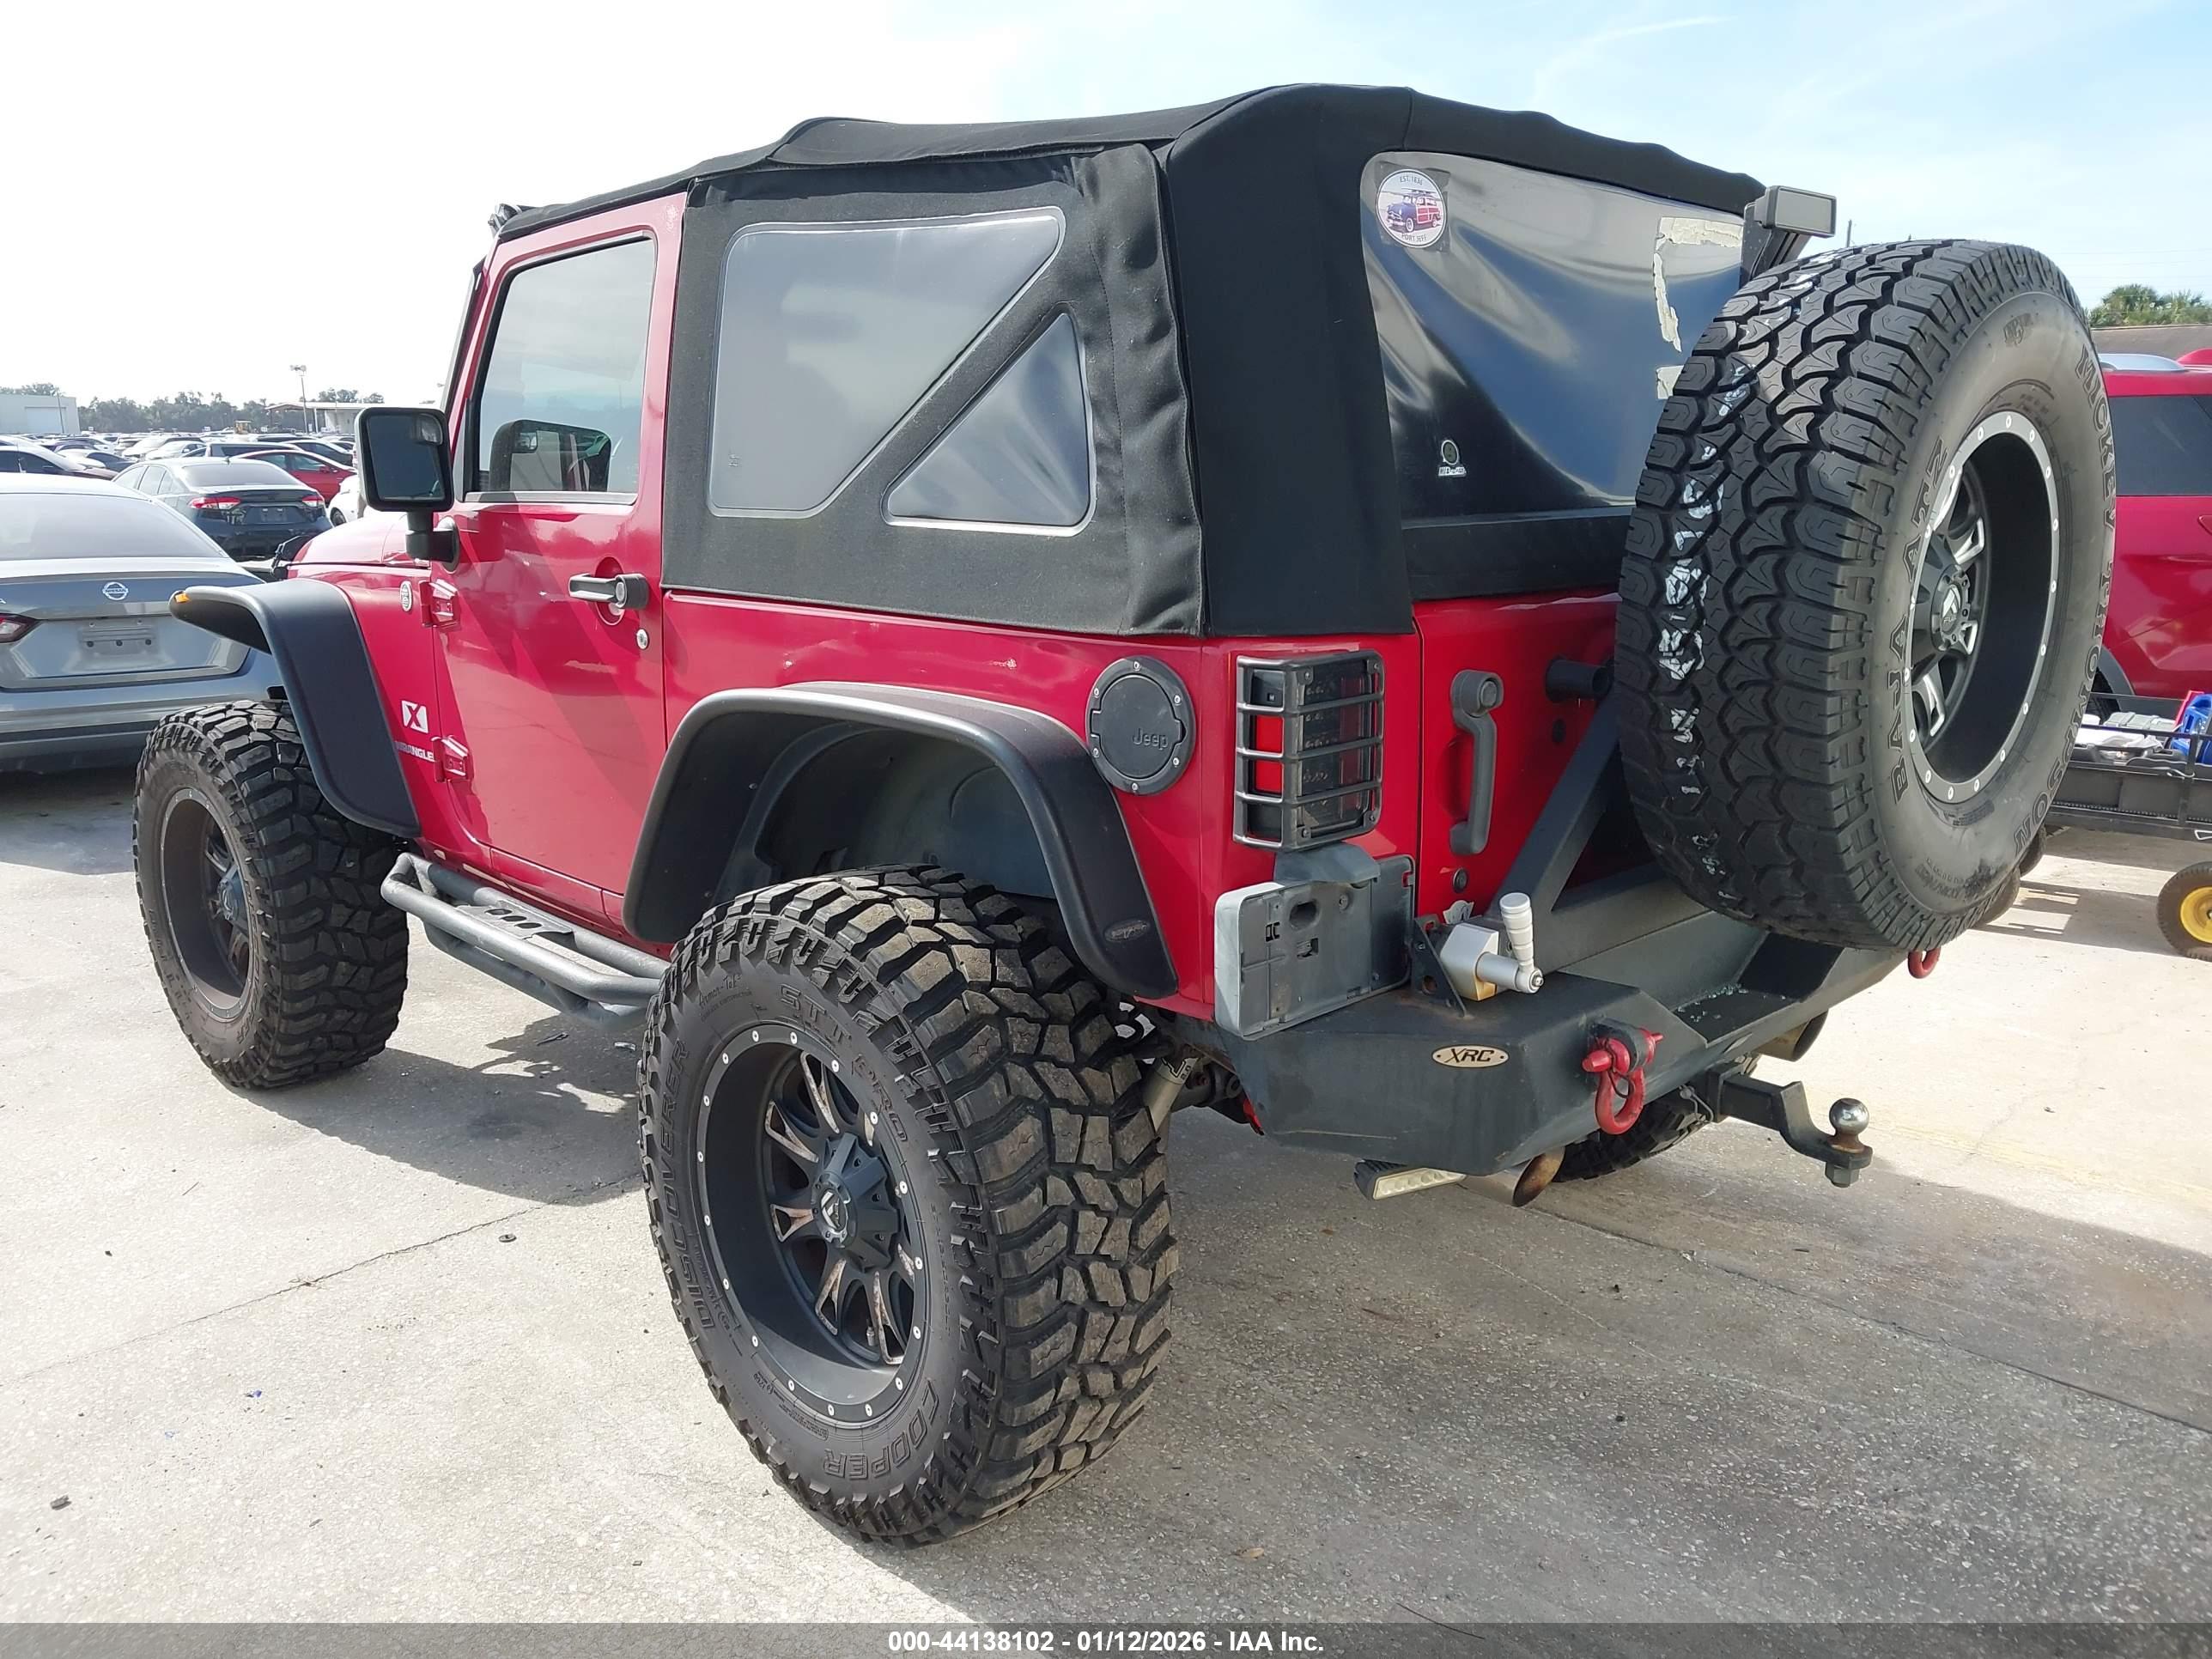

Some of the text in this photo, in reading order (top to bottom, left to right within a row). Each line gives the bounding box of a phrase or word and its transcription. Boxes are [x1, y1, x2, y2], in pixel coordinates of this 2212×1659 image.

[1888, 614, 1908, 804] BAJA
[1903, 434, 1950, 584] ATZ
[2013, 343, 2116, 859] MICKEY THOMPSON
[1133, 727, 1168, 750] Jeep
[780, 982, 908, 1143] STT PRO
[1444, 1048, 1495, 1063] XRC
[659, 1036, 715, 1329] DISCOVERER
[823, 1376, 939, 1480] COOPER
